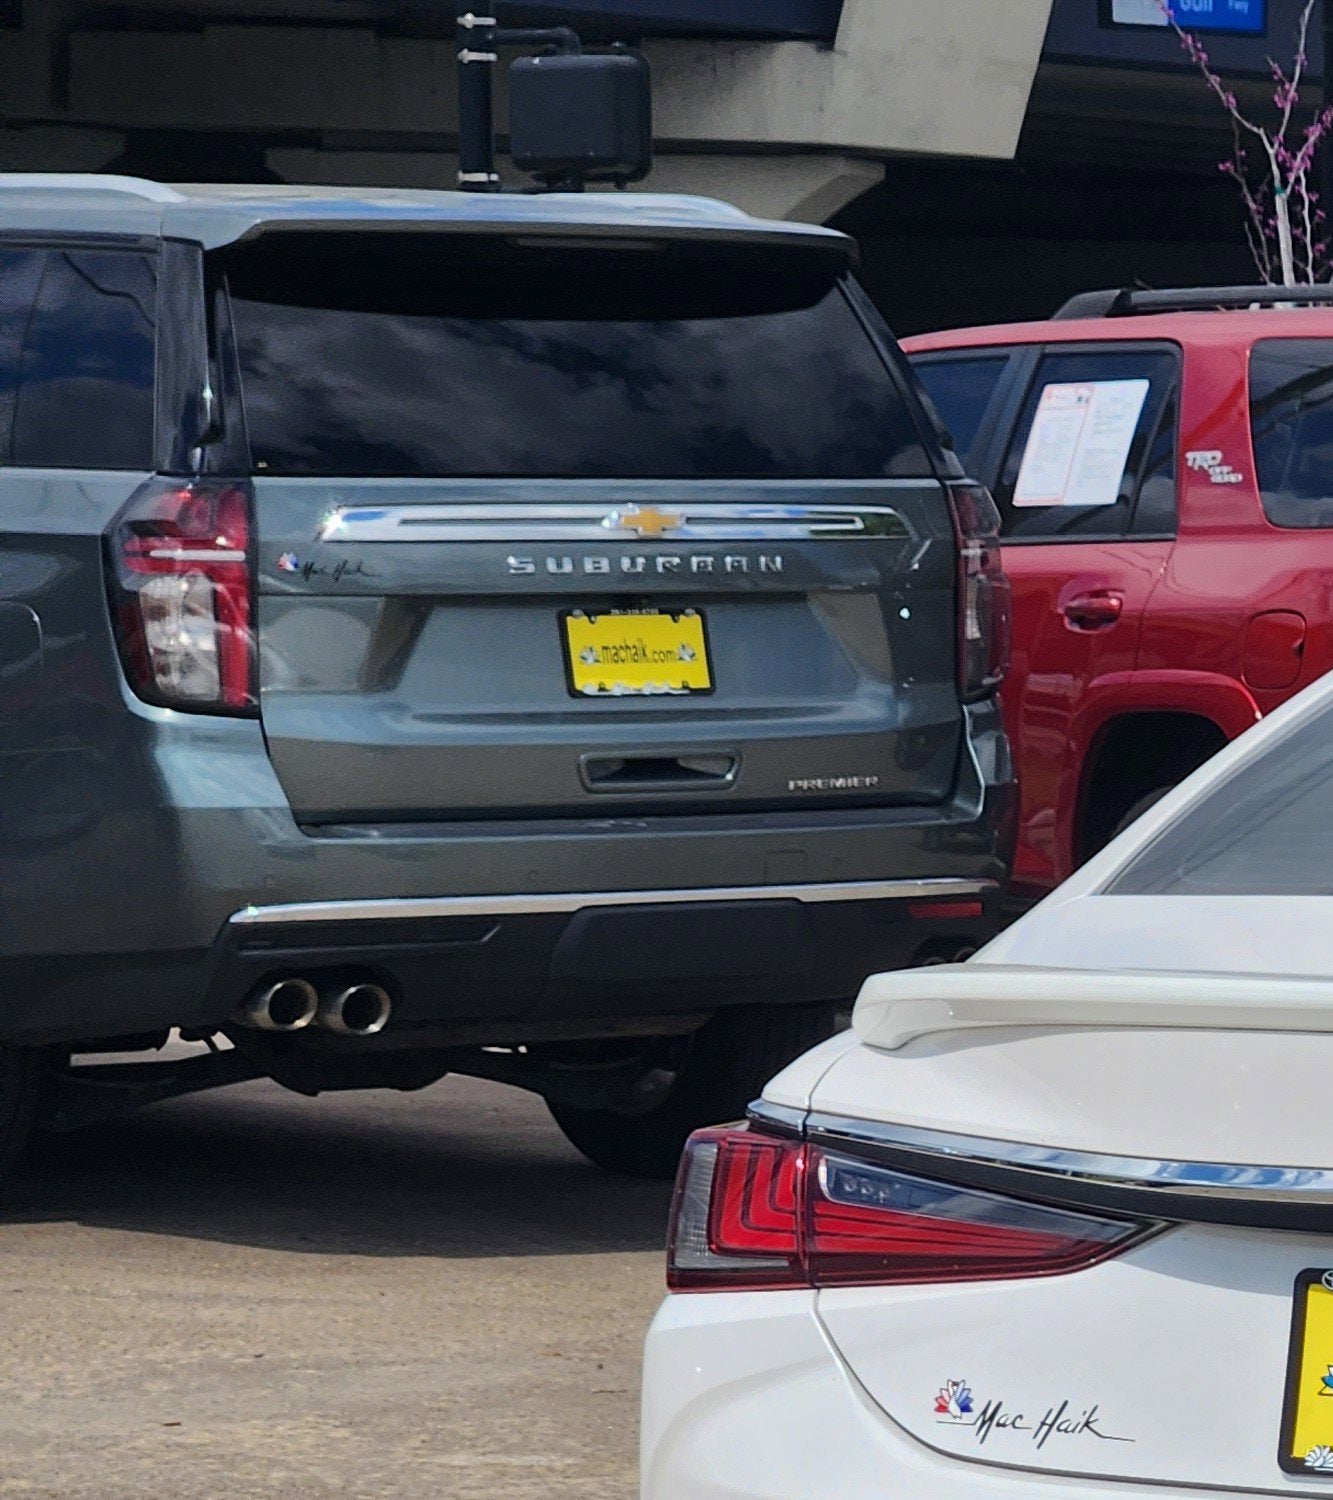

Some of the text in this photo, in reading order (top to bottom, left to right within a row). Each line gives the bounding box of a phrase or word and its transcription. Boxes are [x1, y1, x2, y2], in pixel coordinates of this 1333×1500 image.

[507, 554, 784, 574] SUBURBAN
[788, 776, 879, 791] PREMIER
[960, 1399, 1122, 1450] Mac Haik
